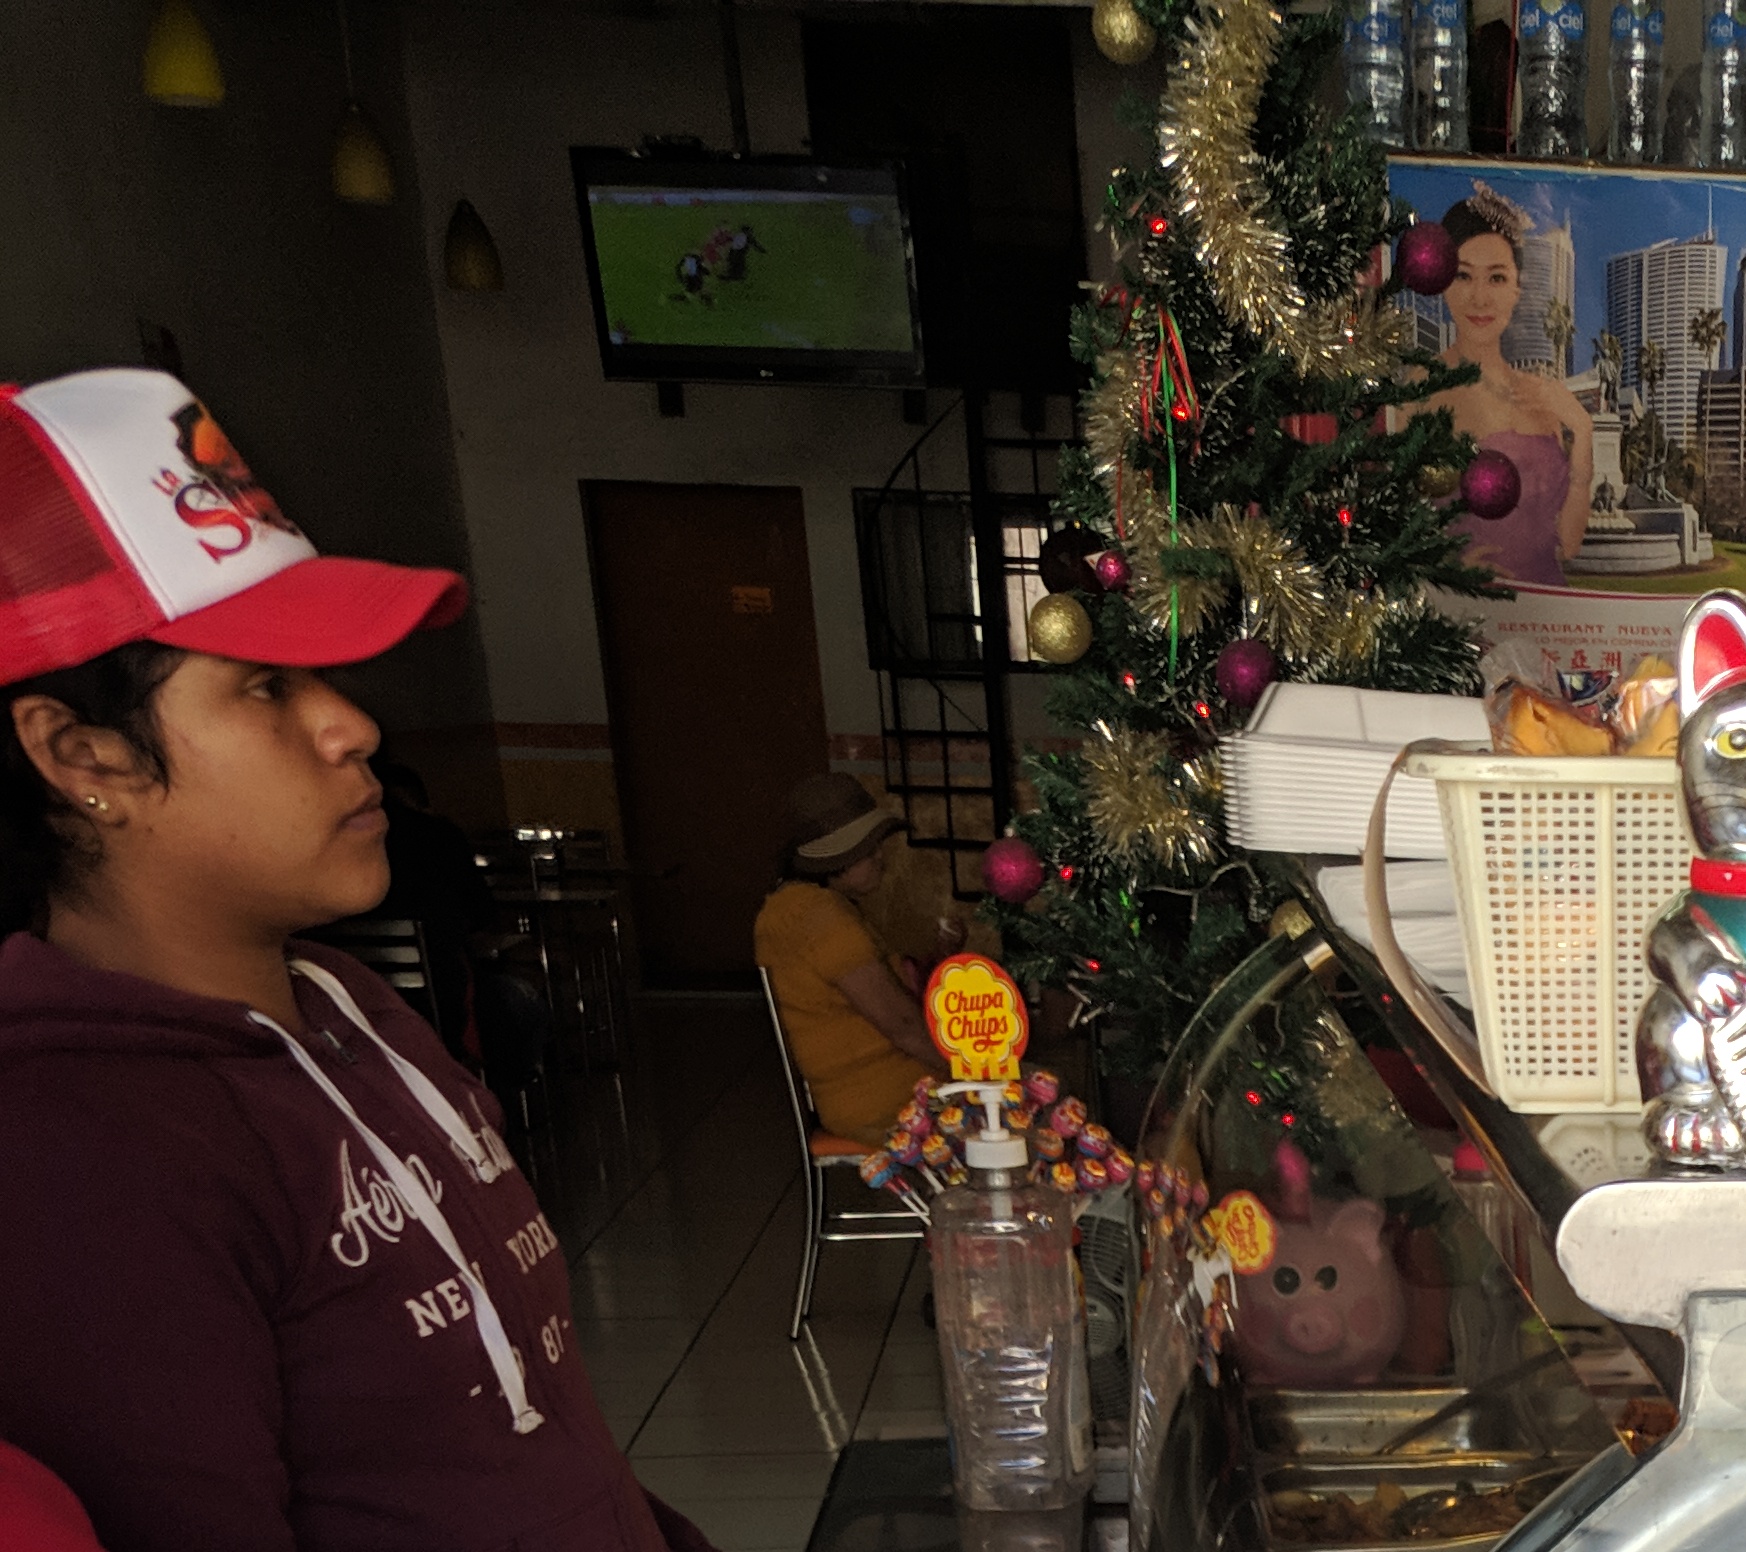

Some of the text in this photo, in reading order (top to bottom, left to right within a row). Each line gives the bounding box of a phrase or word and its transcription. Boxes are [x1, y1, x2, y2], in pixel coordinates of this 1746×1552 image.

[1558, 8, 1584, 30] ciel
[1497, 622, 1673, 637] RESTAURANT NUEVA
[944, 990, 1004, 1018] Chupa
[947, 1015, 1008, 1053] Chups
